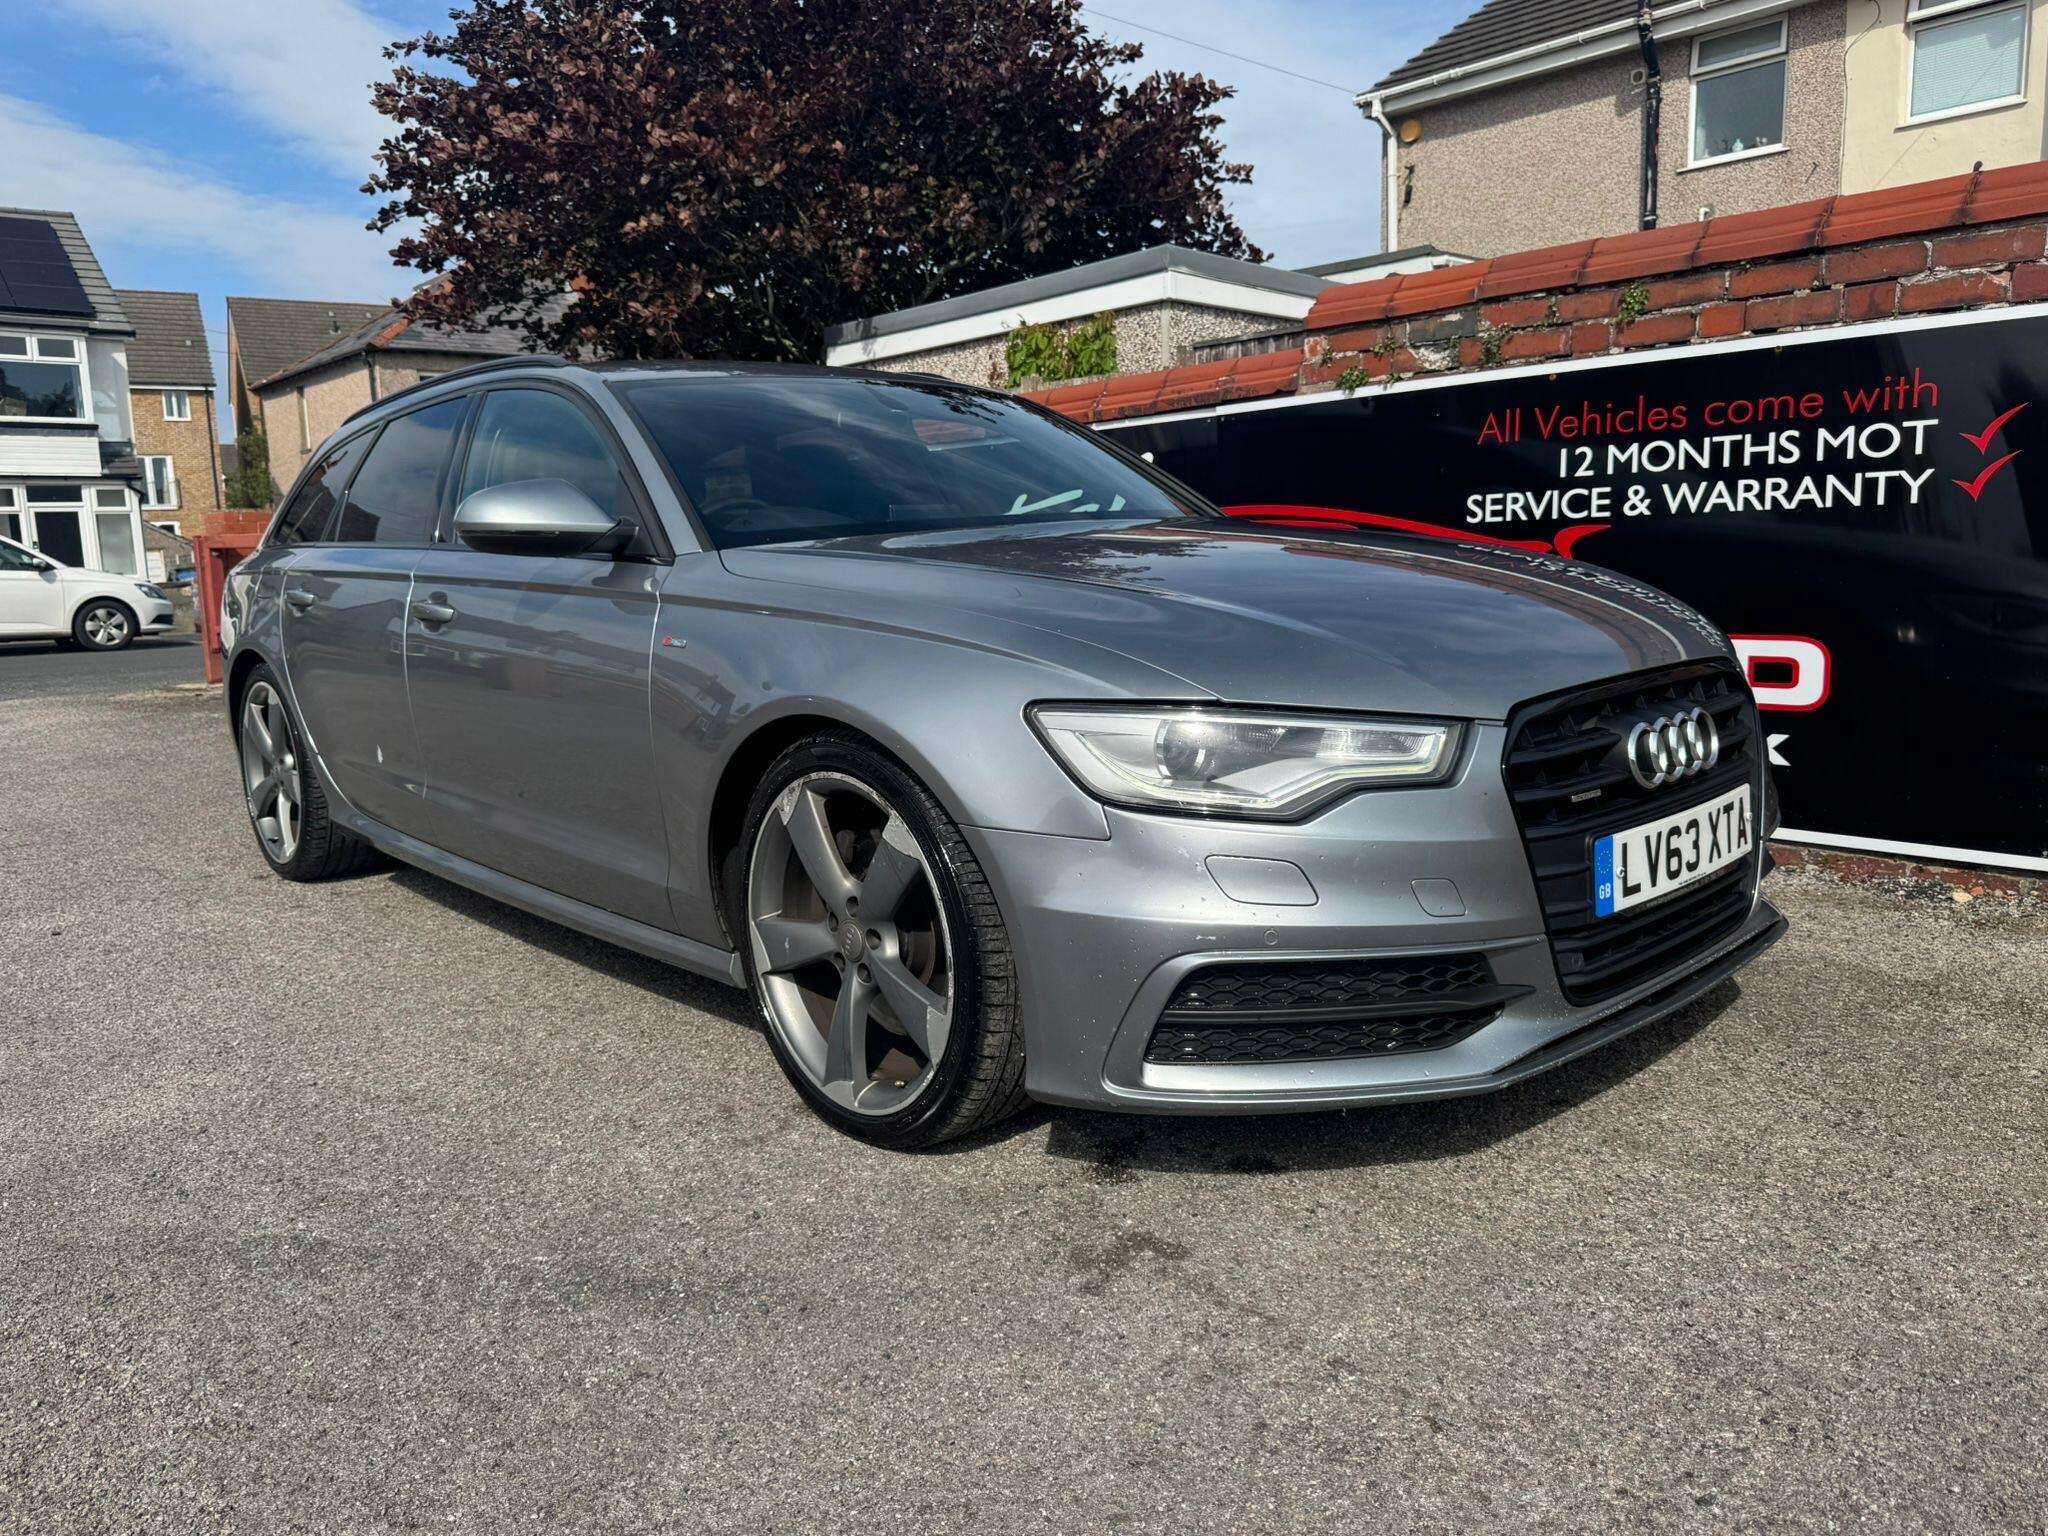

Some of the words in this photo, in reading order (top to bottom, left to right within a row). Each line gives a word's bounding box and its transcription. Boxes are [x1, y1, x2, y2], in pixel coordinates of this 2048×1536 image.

[1477, 408, 1522, 444] All
[1535, 397, 1688, 440] Vehicles
[1703, 392, 1826, 426] come
[1842, 367, 1941, 414] with
[1559, 445, 1596, 478] 12
[1606, 429, 1801, 475] MONTHS
[1816, 418, 1940, 462] MOT
[1466, 486, 1612, 524] SERVICE
[1622, 484, 1653, 517] &
[1661, 468, 1936, 515] WARRANTY
[1620, 817, 1701, 899] LV63
[1707, 796, 1749, 864] XTA
[1599, 882, 1612, 900] GB
